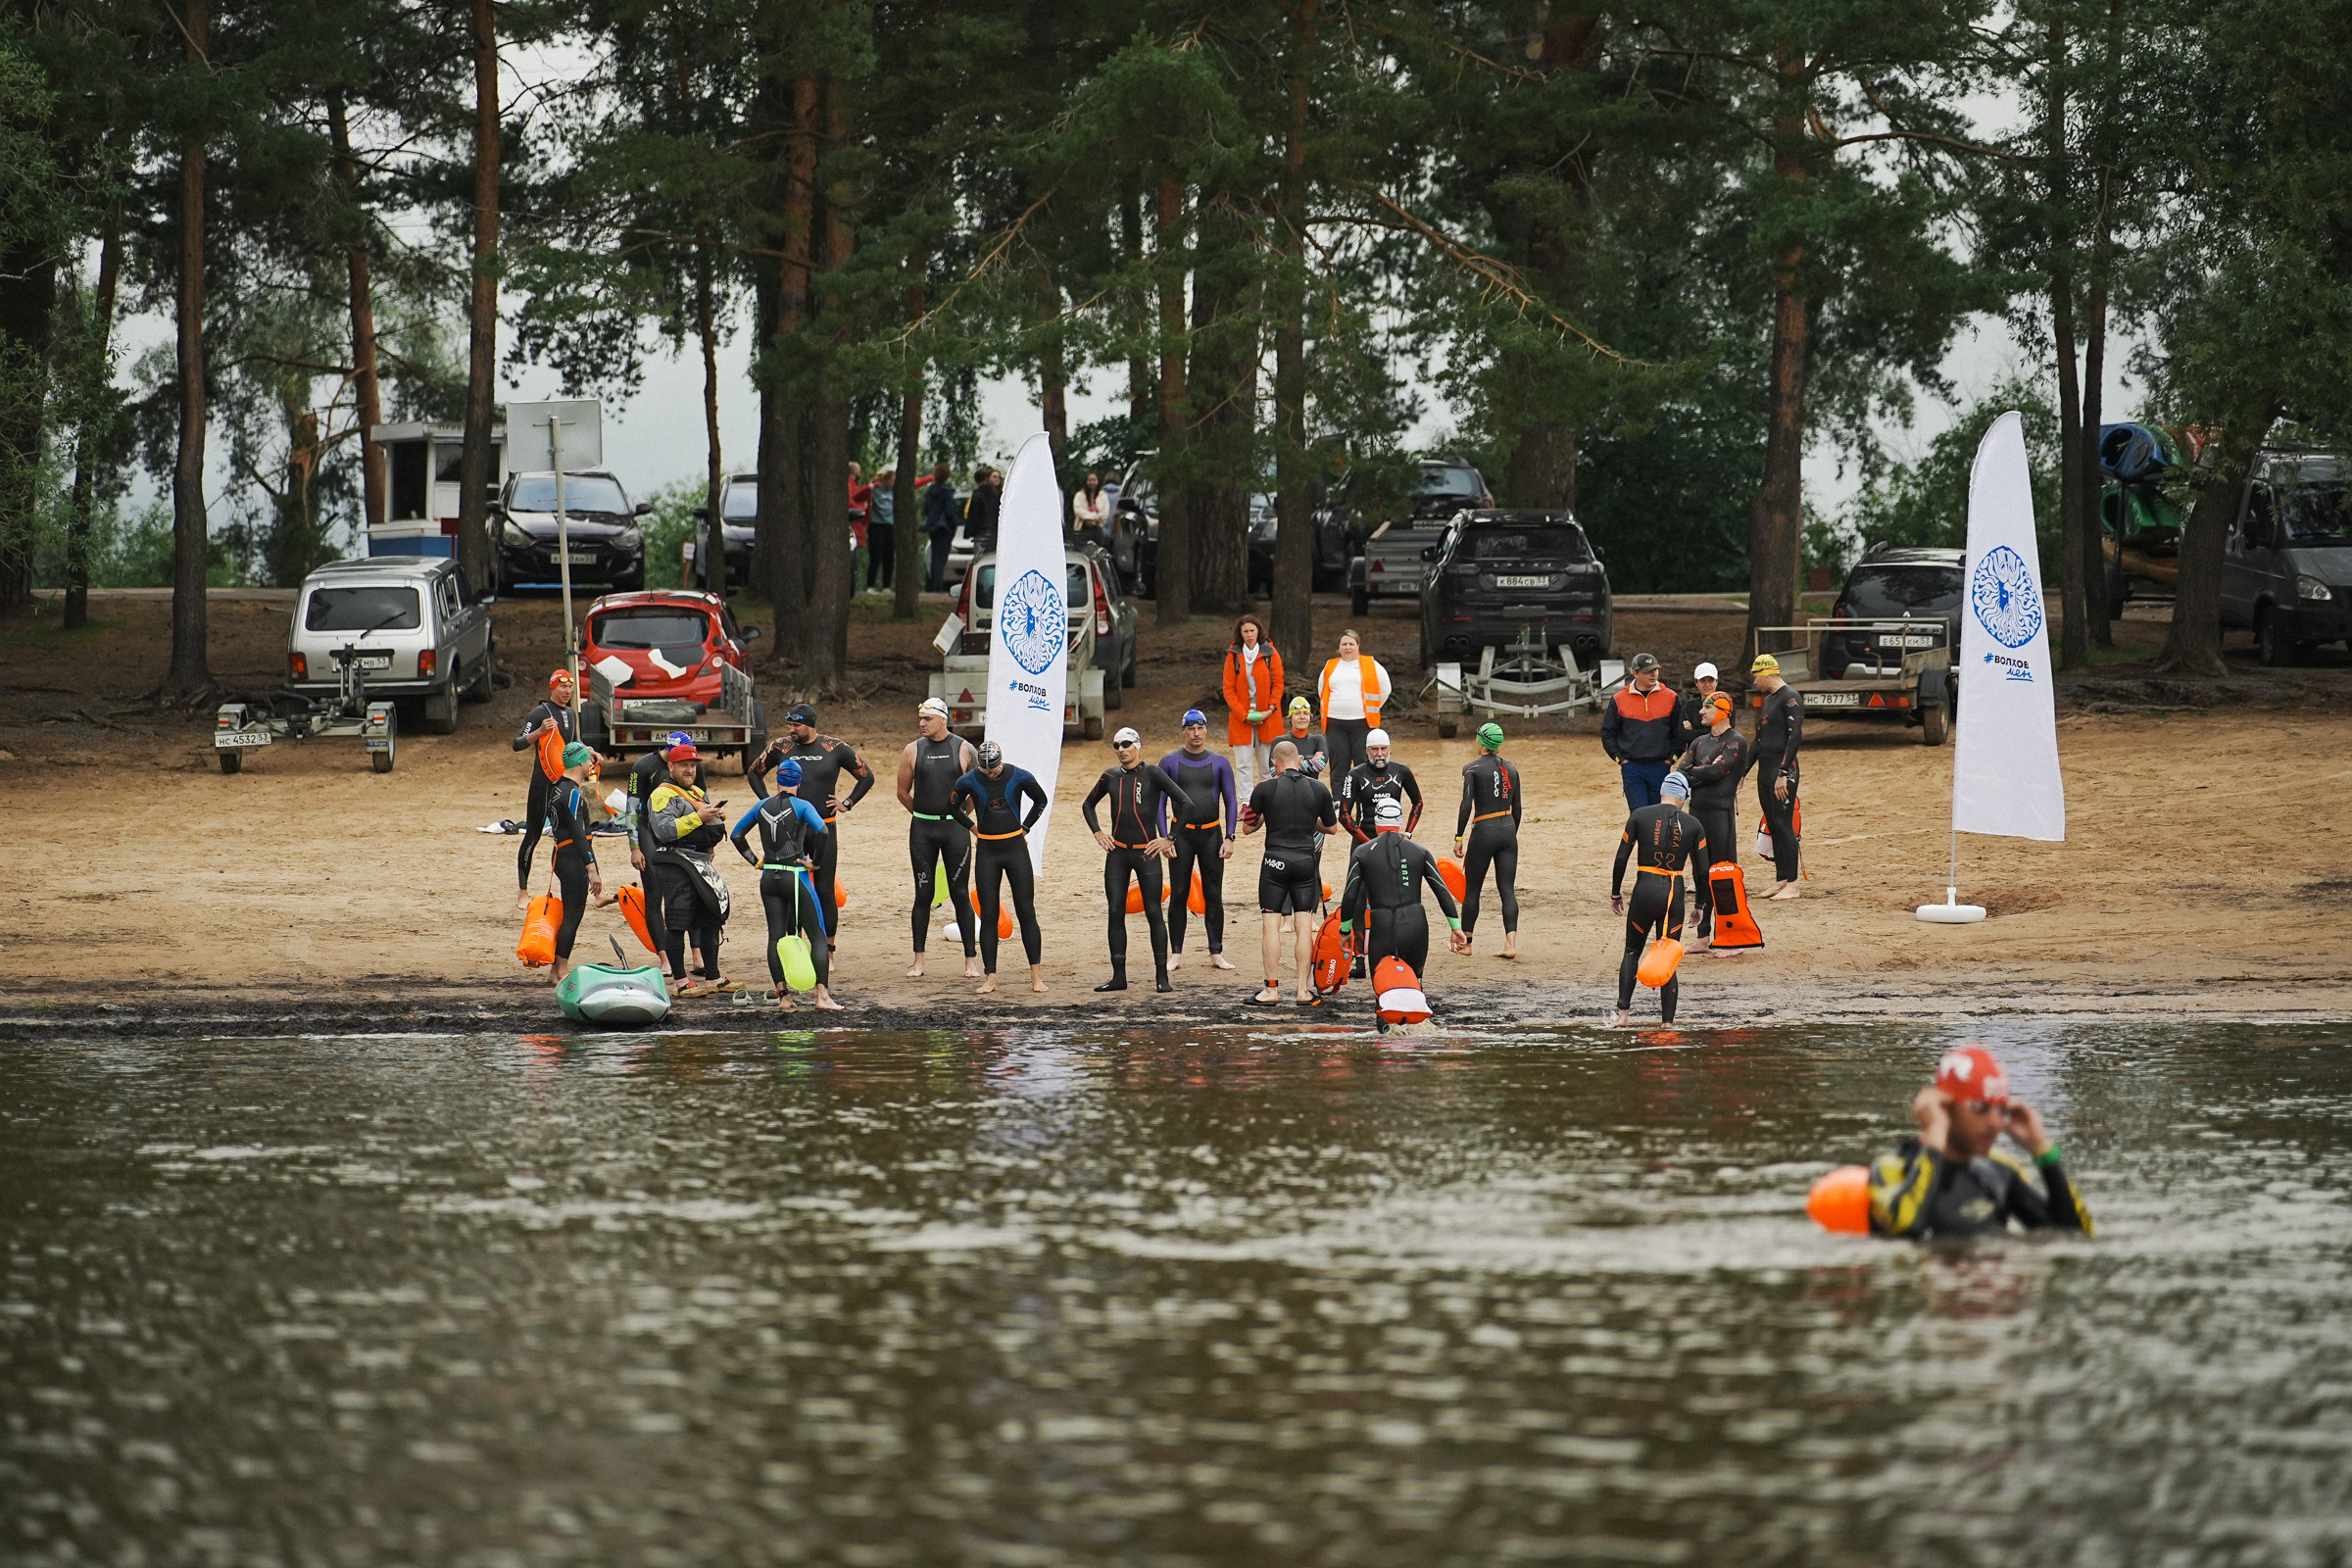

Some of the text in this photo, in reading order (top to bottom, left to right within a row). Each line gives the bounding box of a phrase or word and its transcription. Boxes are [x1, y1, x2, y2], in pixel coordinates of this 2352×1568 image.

[1008, 679, 1047, 697] #ВОЛХОВ
[1821, 694, 1844, 705] 7877
[219, 737, 231, 746] НС
[232, 735, 257, 745] 4532
[1653, 818, 1663, 846] MAVERICK
[1400, 858, 1410, 887] AZURE
[1326, 958, 1338, 985] OWS500
